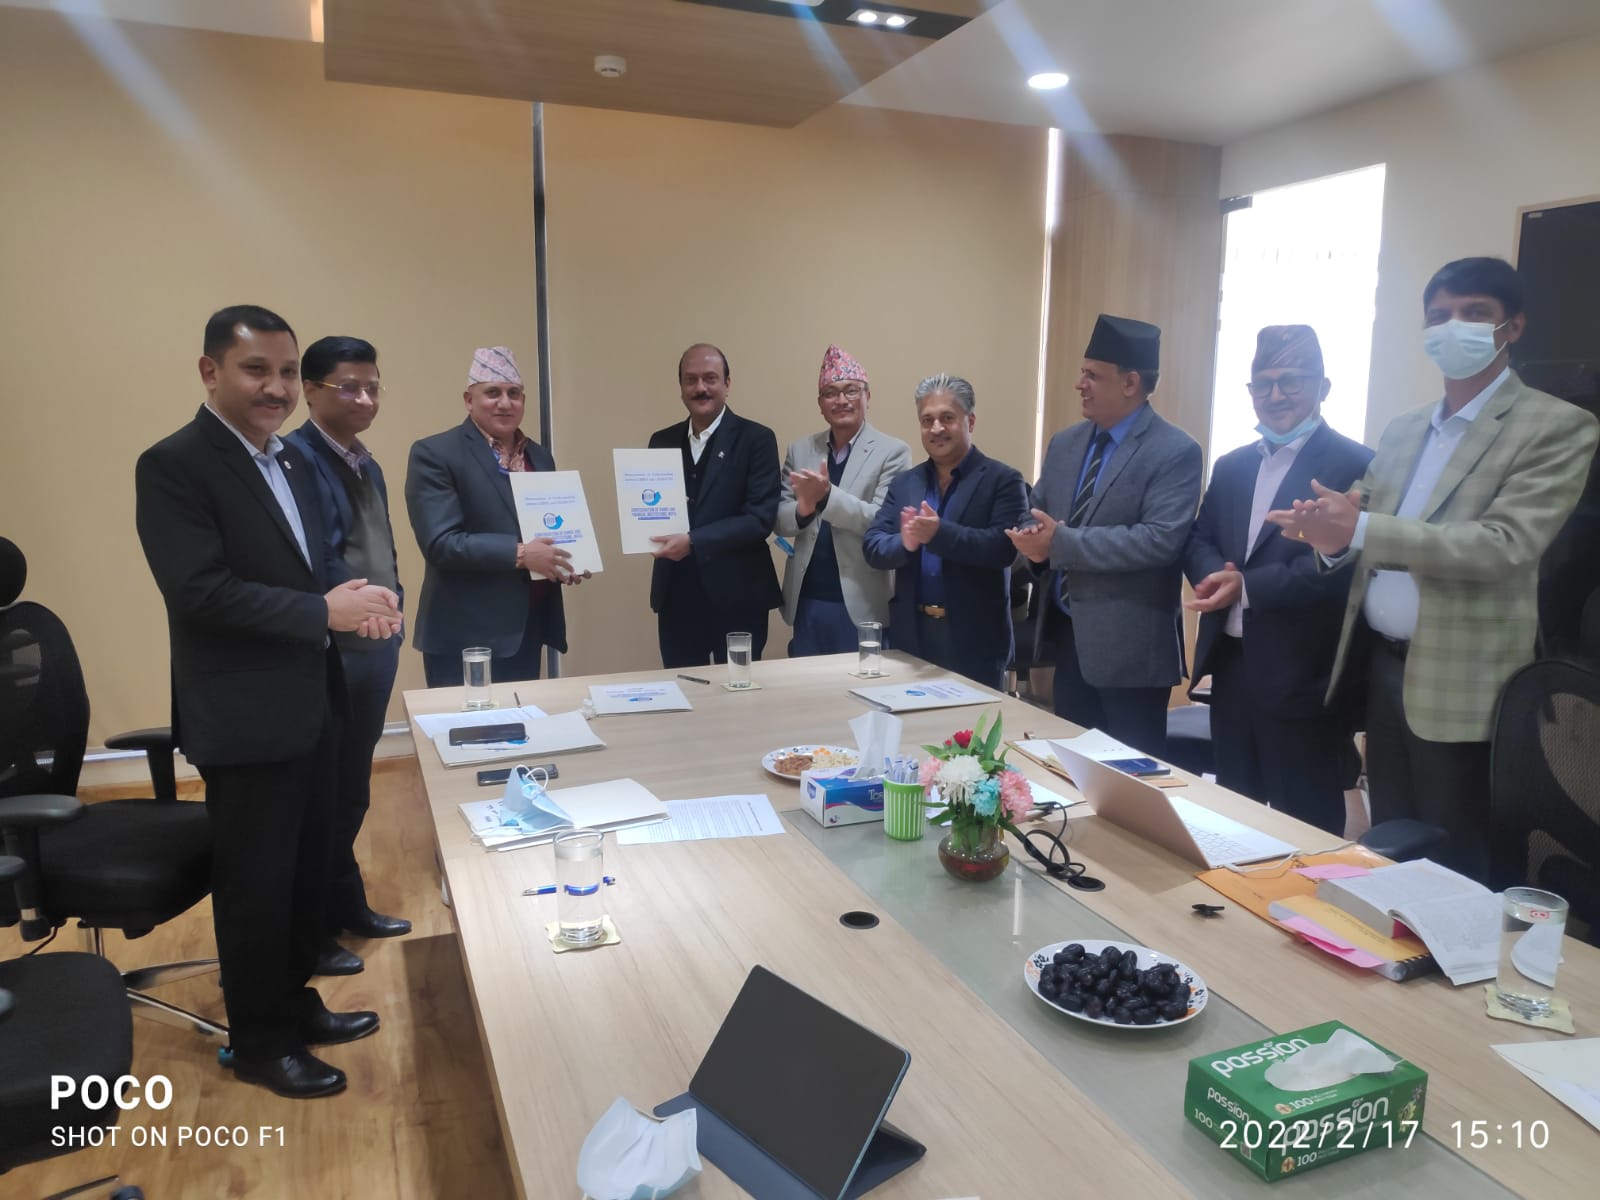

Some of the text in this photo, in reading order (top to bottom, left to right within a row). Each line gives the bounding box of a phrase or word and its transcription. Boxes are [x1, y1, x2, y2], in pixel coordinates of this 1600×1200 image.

[1210, 1038, 1312, 1078] passion
[1207, 1087, 1250, 1123] passion
[1289, 1097, 1314, 1109] 100
[1194, 1108, 1213, 1129] 100
[1281, 1097, 1389, 1156] passion
[1296, 1152, 1317, 1167] 100
